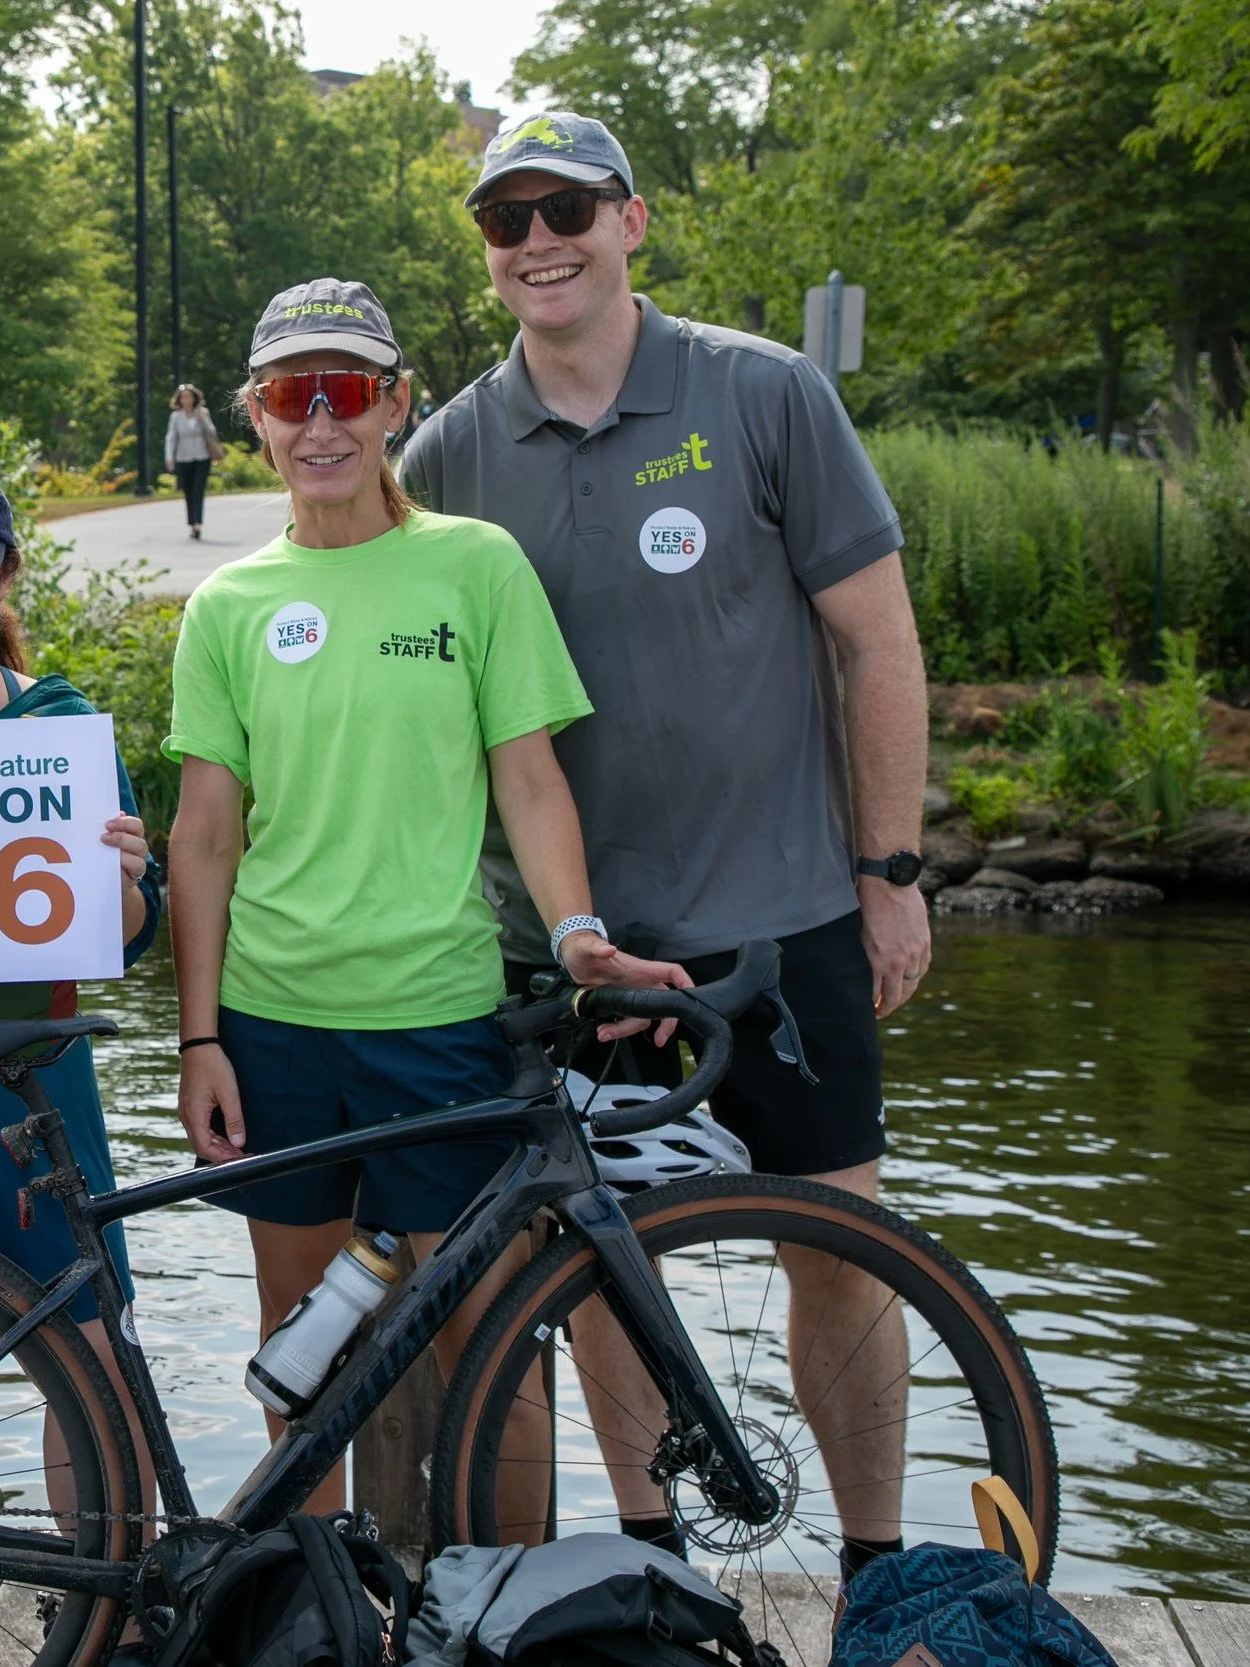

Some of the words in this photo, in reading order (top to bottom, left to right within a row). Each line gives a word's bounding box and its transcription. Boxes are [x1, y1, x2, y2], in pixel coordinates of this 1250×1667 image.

[284, 301, 364, 320] trustees
[645, 451, 688, 470] trustees
[635, 460, 689, 486] STAFF
[651, 531, 682, 543] YES
[682, 538, 695, 555] 6
[278, 622, 305, 638] YES
[305, 628, 318, 644] 6
[391, 632, 435, 645] trustees
[379, 642, 435, 660] STAFF
